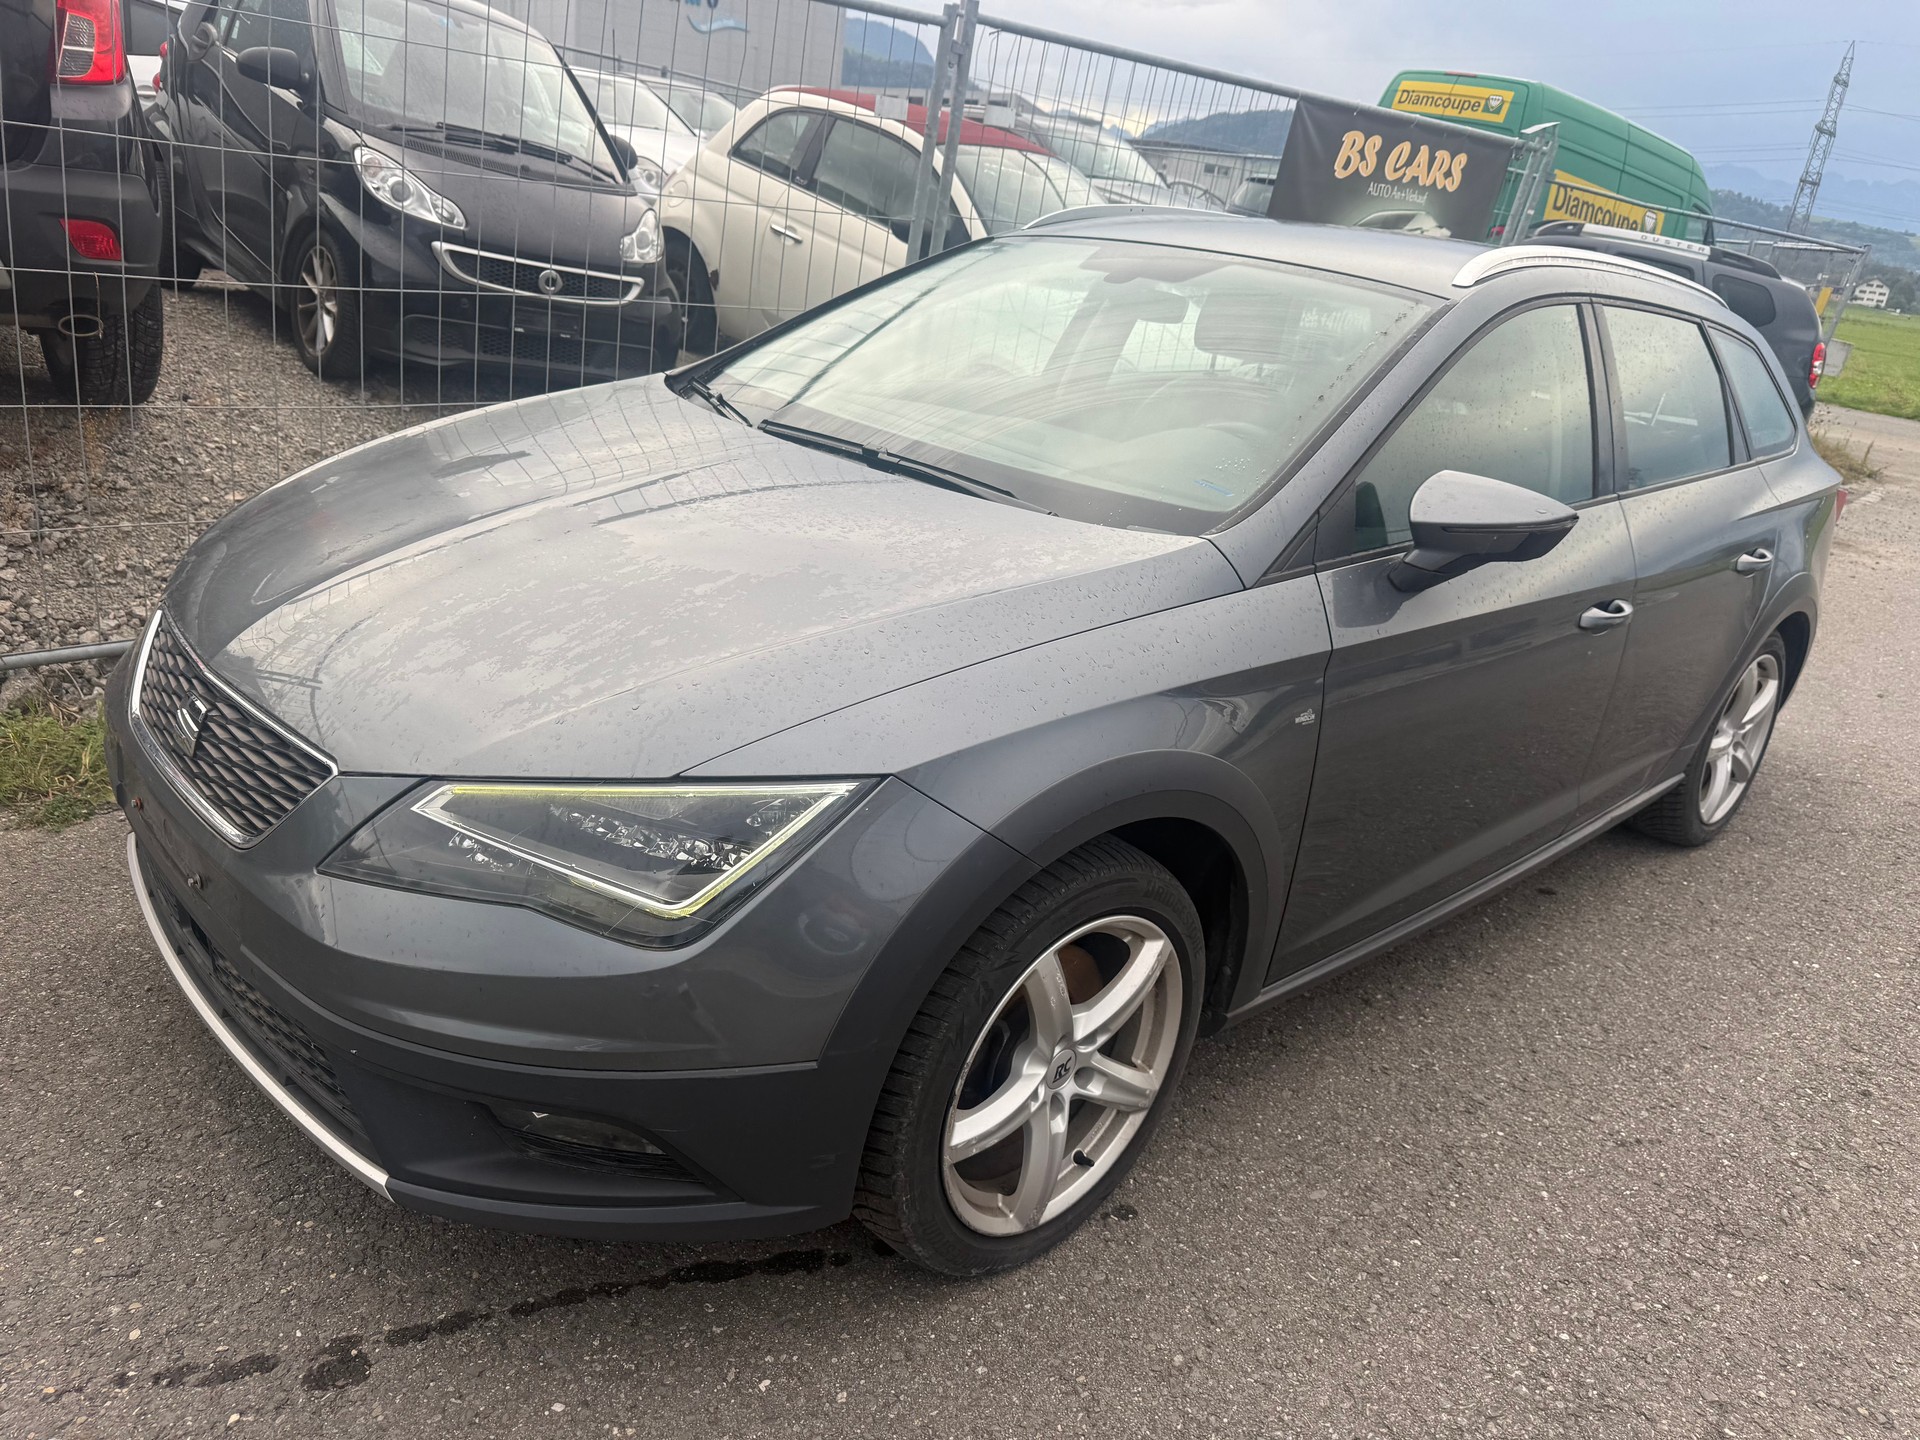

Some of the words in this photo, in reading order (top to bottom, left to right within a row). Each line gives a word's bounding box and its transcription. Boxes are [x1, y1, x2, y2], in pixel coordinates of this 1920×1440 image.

[1398, 89, 1481, 114] Diamcoupe
[1334, 130, 1382, 179] BS
[1384, 141, 1467, 192] CARS
[1366, 181, 1391, 198] AUTO
[1640, 234, 1706, 252] DUSTER
